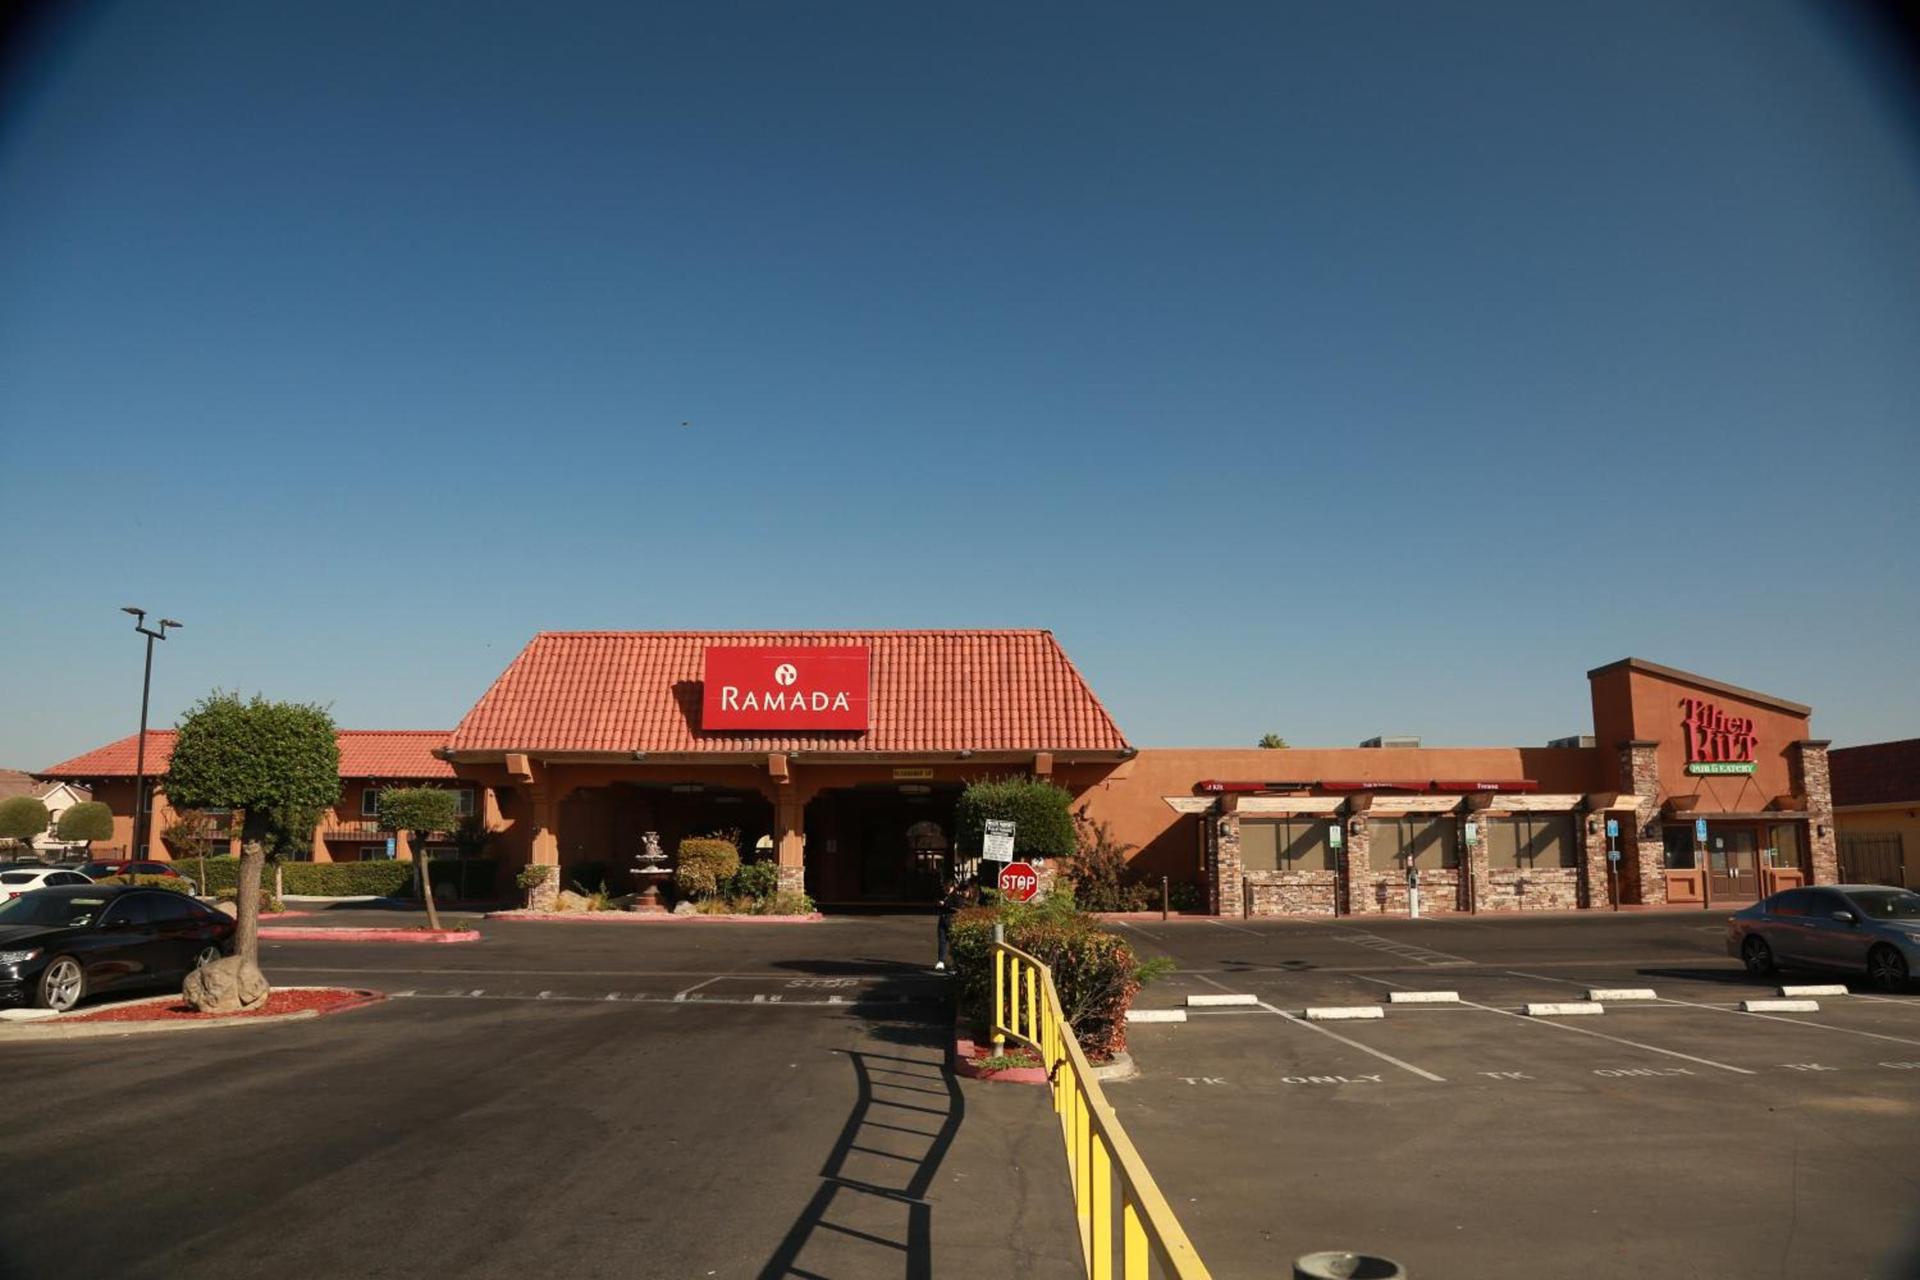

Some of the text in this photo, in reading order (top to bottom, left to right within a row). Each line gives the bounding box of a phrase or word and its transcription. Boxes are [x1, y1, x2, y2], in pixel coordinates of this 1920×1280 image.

[721, 686, 850, 711] RAMADA
[1001, 874, 1035, 891] STOP
[1176, 1077, 1229, 1086] TK
[1280, 1074, 1383, 1085] ONLY
